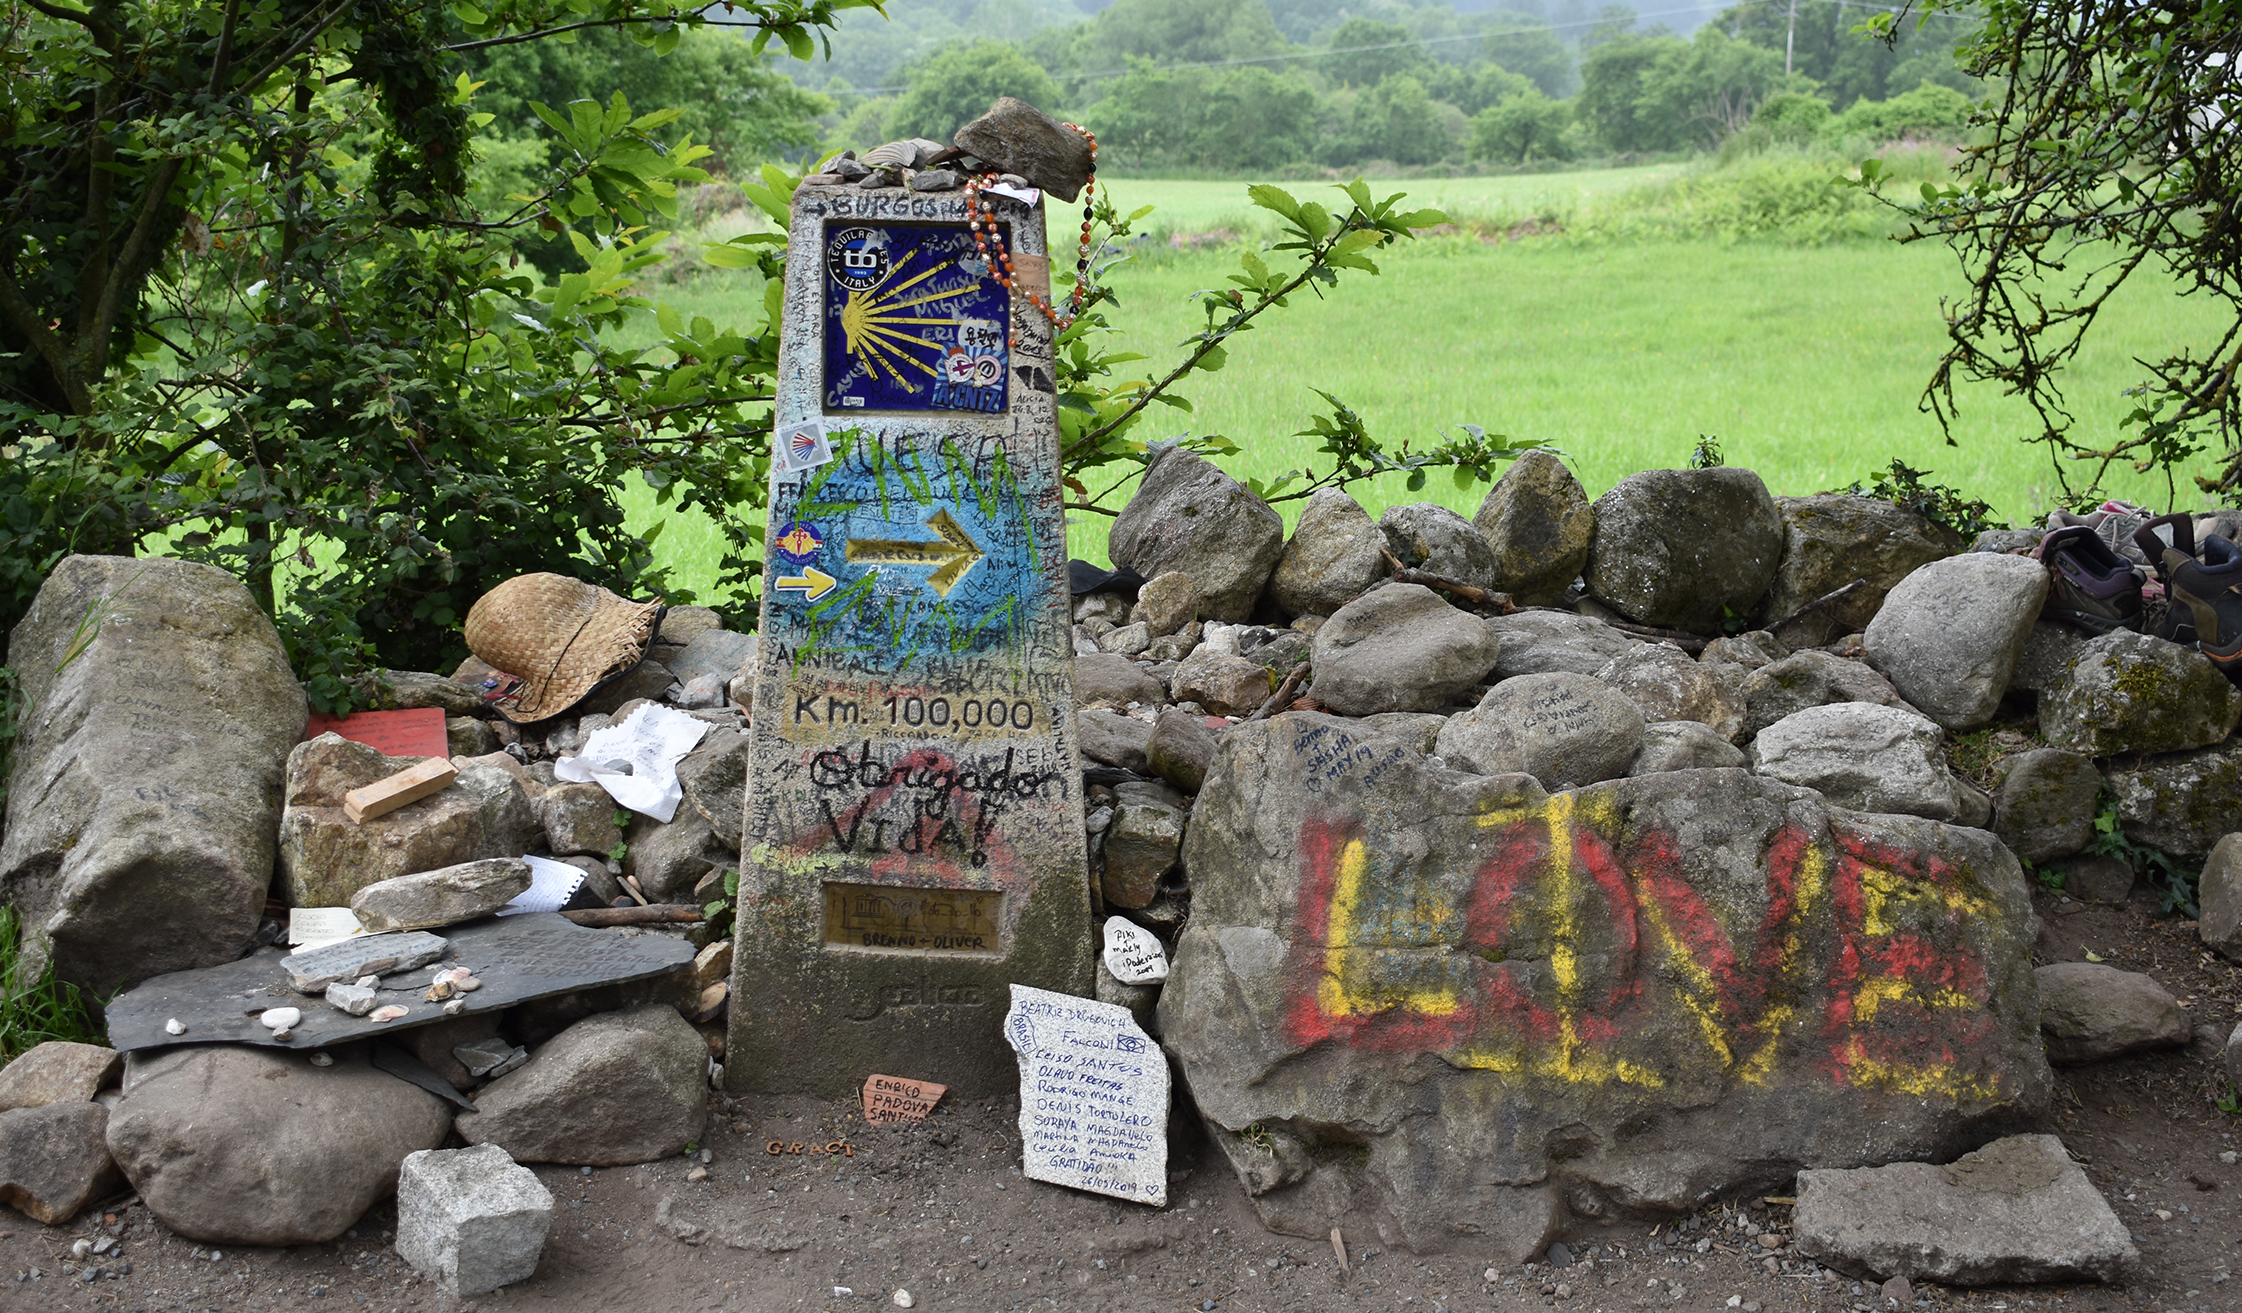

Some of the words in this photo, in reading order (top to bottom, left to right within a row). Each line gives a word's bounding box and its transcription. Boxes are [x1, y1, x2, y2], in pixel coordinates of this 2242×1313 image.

[844, 276, 876, 287] ITALY
[795, 696, 868, 724] Km.
[884, 696, 1034, 733] 100,000
[1307, 734, 1352, 774] SASHA
[1326, 752, 1354, 781] MAY
[1355, 745, 1373, 762] 19
[933, 934, 987, 949] OLIVER
[1019, 1000, 1063, 1018] BEATRIZ
[1013, 1017, 1032, 1051] BRASIL
[1062, 1030, 1114, 1050] FALCONI
[875, 1079, 921, 1099] ENRICO
[1038, 1079, 1086, 1098] RODRIGO
[1078, 1073, 1124, 1091] FREITAS
[873, 1093, 929, 1112] PADOVA
[1037, 1098, 1082, 1114] DENIS
[1033, 1114, 1078, 1131] SORAYA
[1081, 1175, 1138, 1194] 26/05/2019
